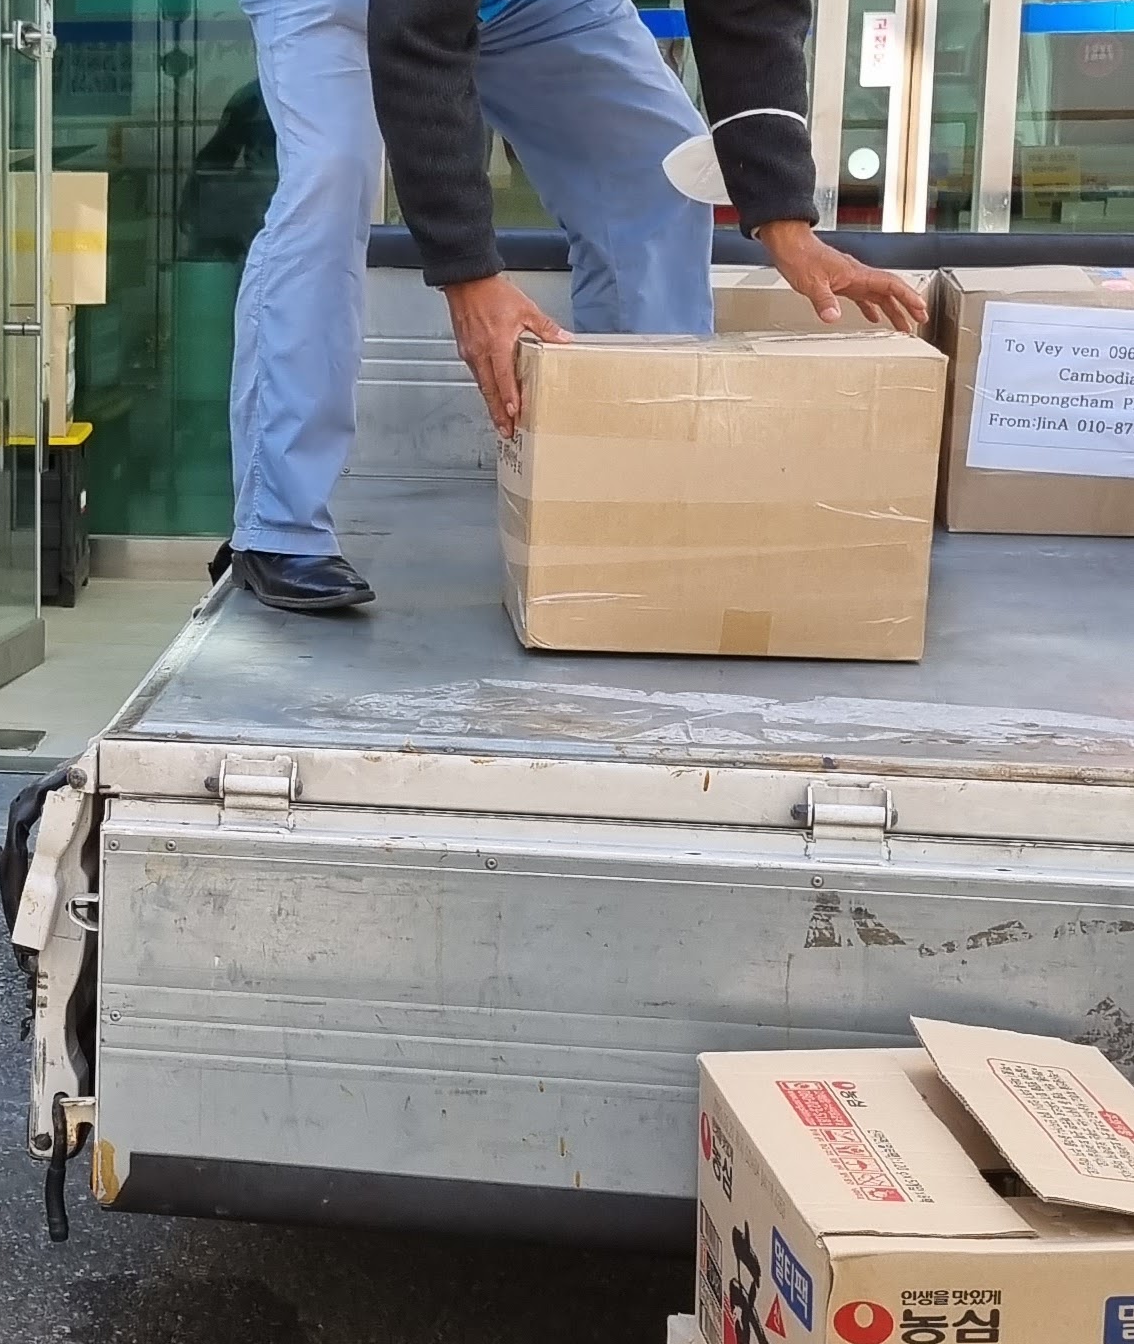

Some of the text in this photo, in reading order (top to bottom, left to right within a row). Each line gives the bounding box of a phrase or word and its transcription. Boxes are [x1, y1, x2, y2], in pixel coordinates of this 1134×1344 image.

[1005, 339, 1025, 353] To
[1034, 341, 1063, 357] Vey
[1072, 346, 1100, 358] ven
[995, 388, 1114, 409] Kampongcham
[988, 413, 1069, 431] From:JinA
[774, 1238, 809, 1320] 멀티팩
[901, 1290, 1002, 1305] 인생을 맛있게
